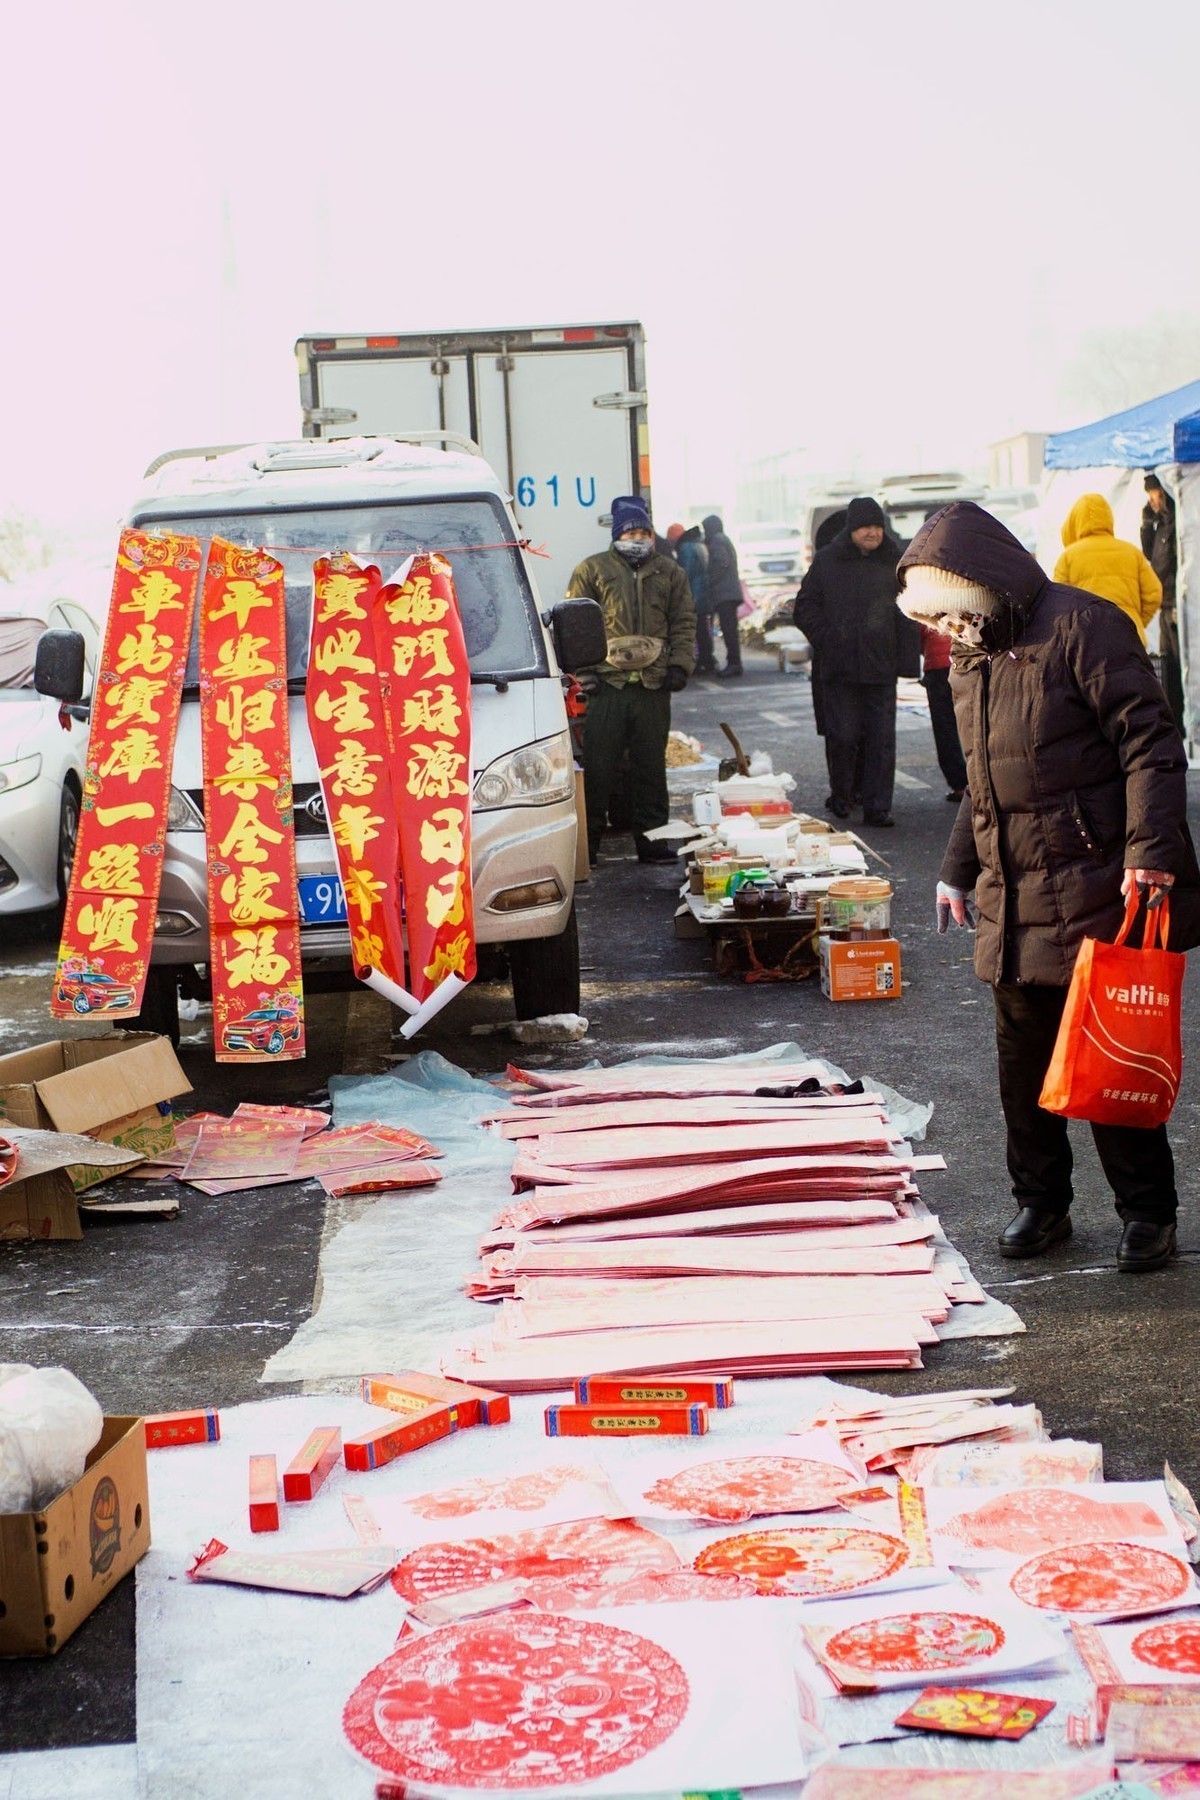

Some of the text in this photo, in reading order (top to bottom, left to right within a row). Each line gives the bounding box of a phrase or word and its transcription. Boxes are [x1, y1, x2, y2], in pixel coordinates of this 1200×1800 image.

[518, 475, 596, 507] 61U
[1102, 1088, 1159, 1104] 节能低碳环保
